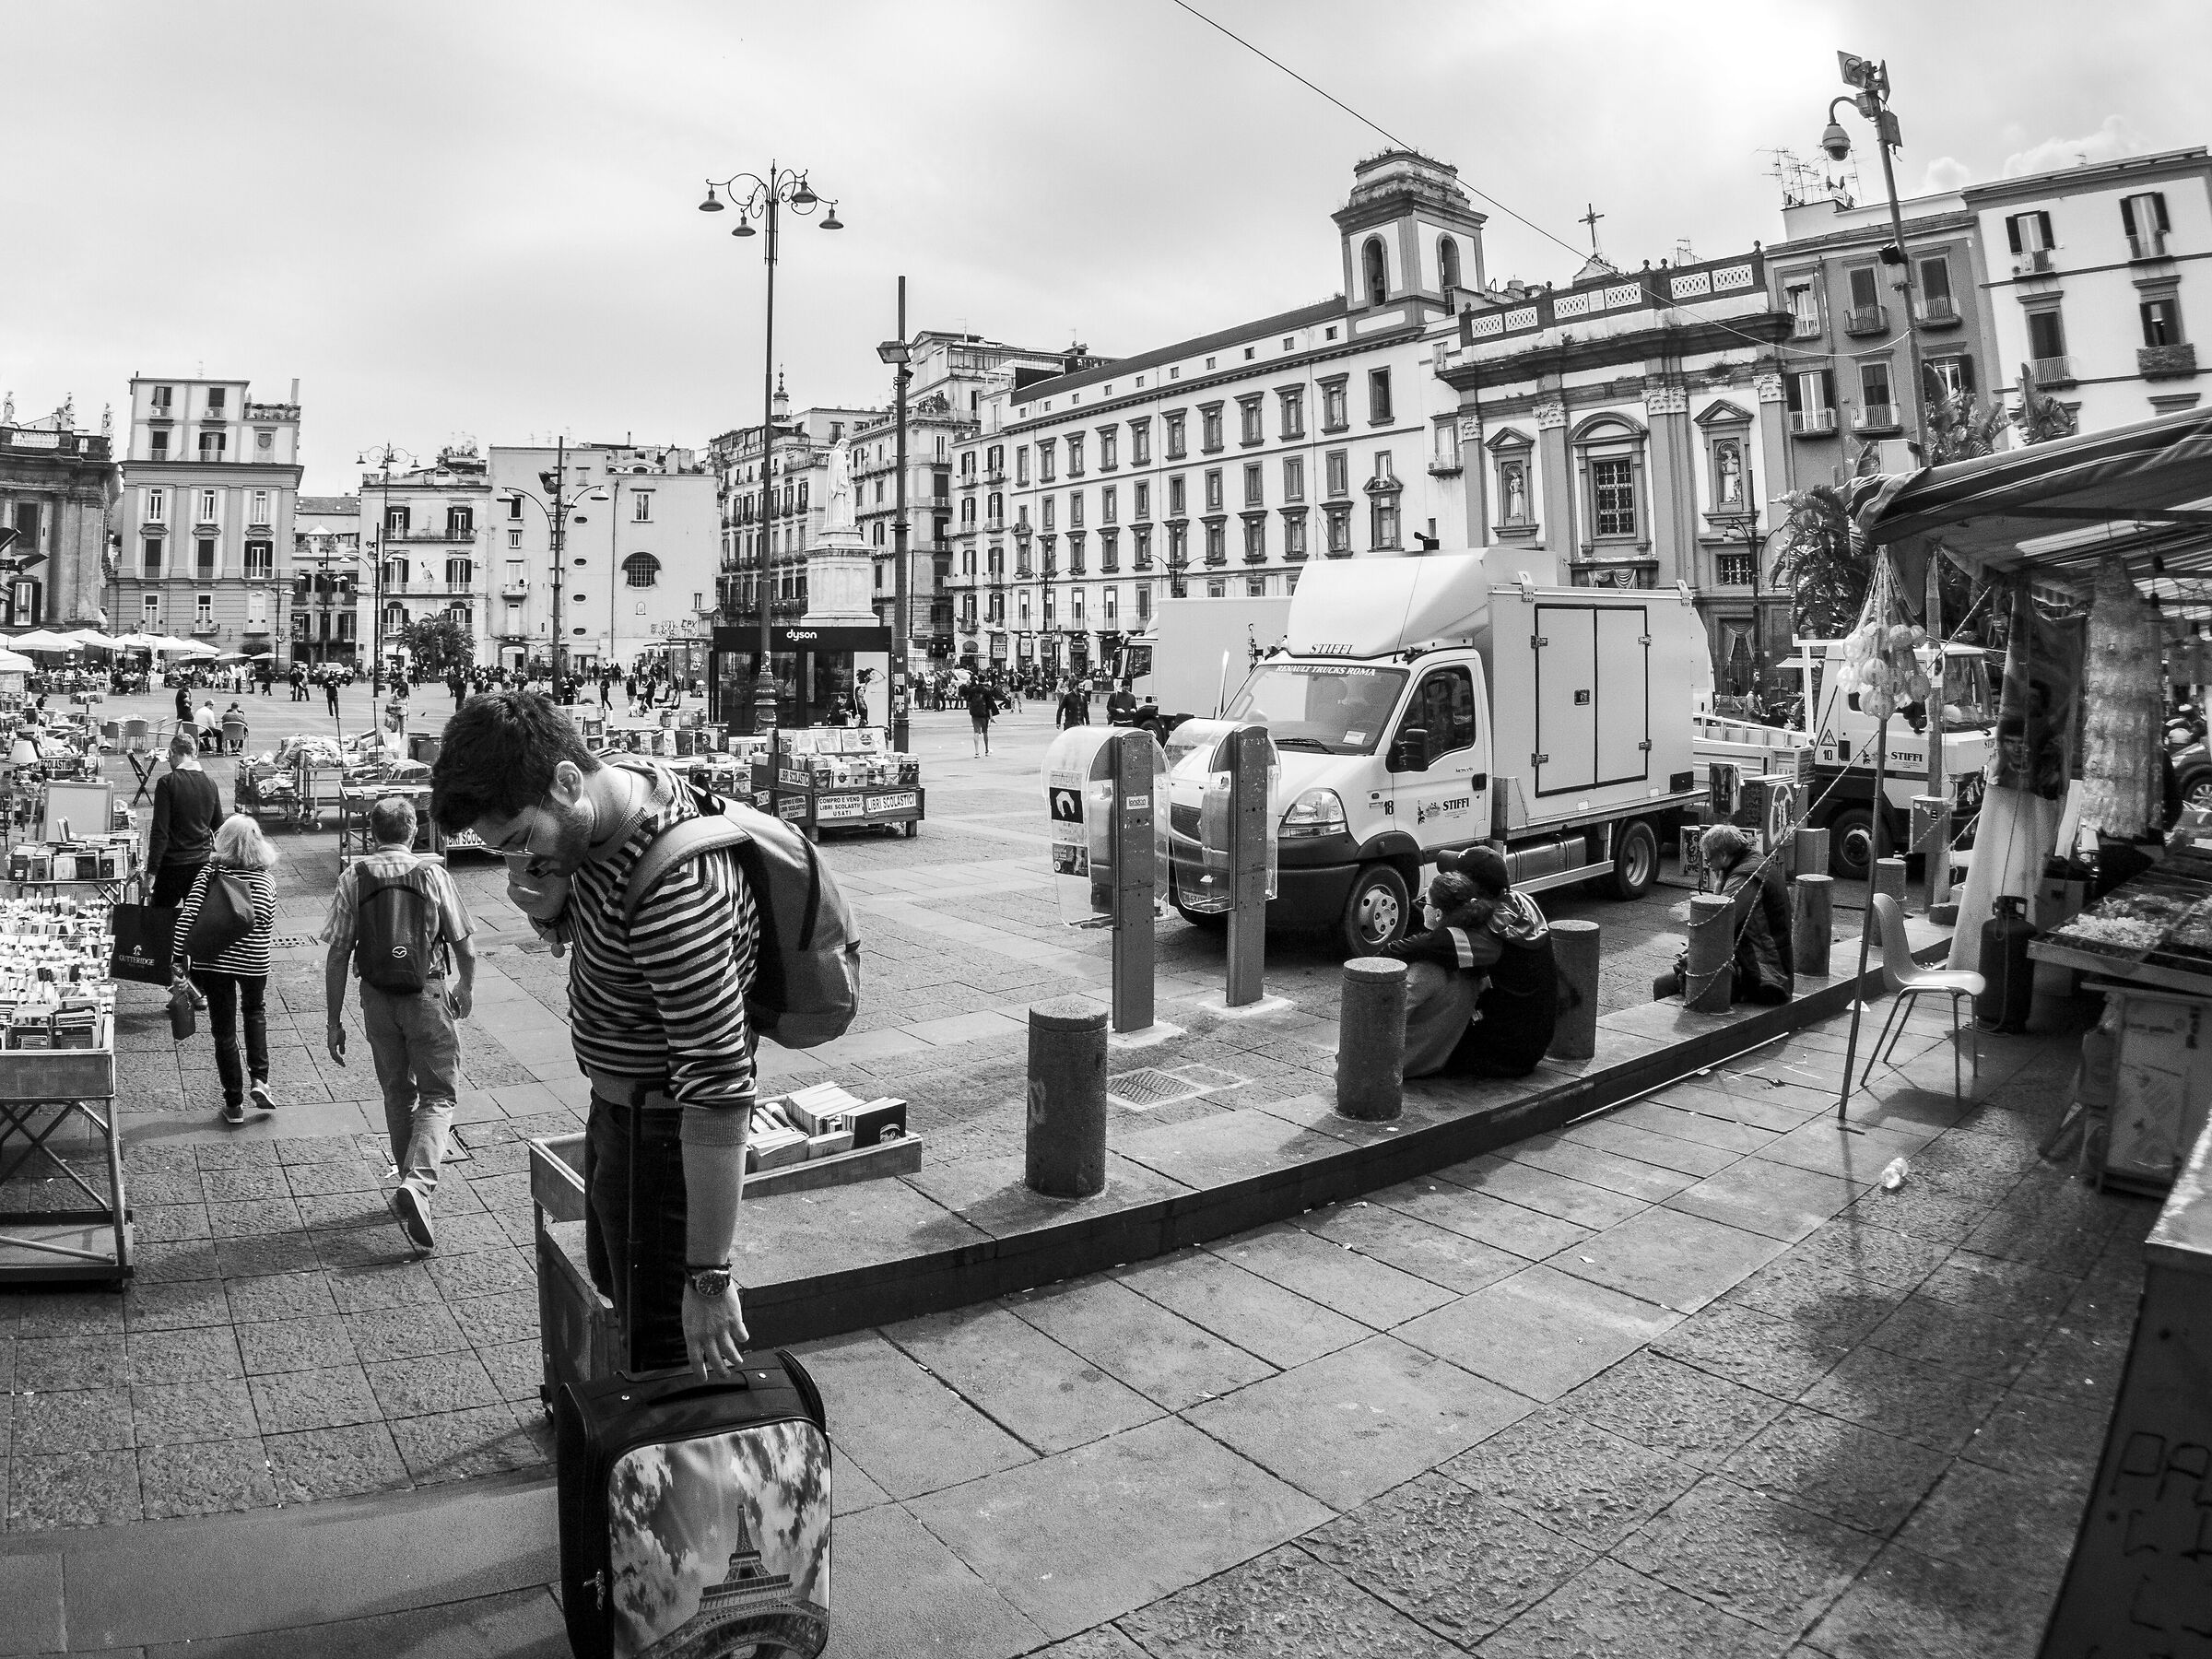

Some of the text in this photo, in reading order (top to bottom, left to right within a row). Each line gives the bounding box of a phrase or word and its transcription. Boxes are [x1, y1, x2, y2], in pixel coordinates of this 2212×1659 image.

[786, 629, 818, 641] dyson
[1310, 644, 1353, 654] STIFFI
[1312, 665, 1347, 674] TRUCKS
[1346, 667, 1376, 676] ROMA
[1822, 749, 1833, 761] 10
[1890, 751, 1923, 762] STIFFI
[866, 794, 915, 811] LIBRI SCOLASTICI
[1383, 800, 1394, 815] 18
[1442, 797, 1469, 811] STIFFI
[119, 955, 155, 966] GUTTERIDGE
